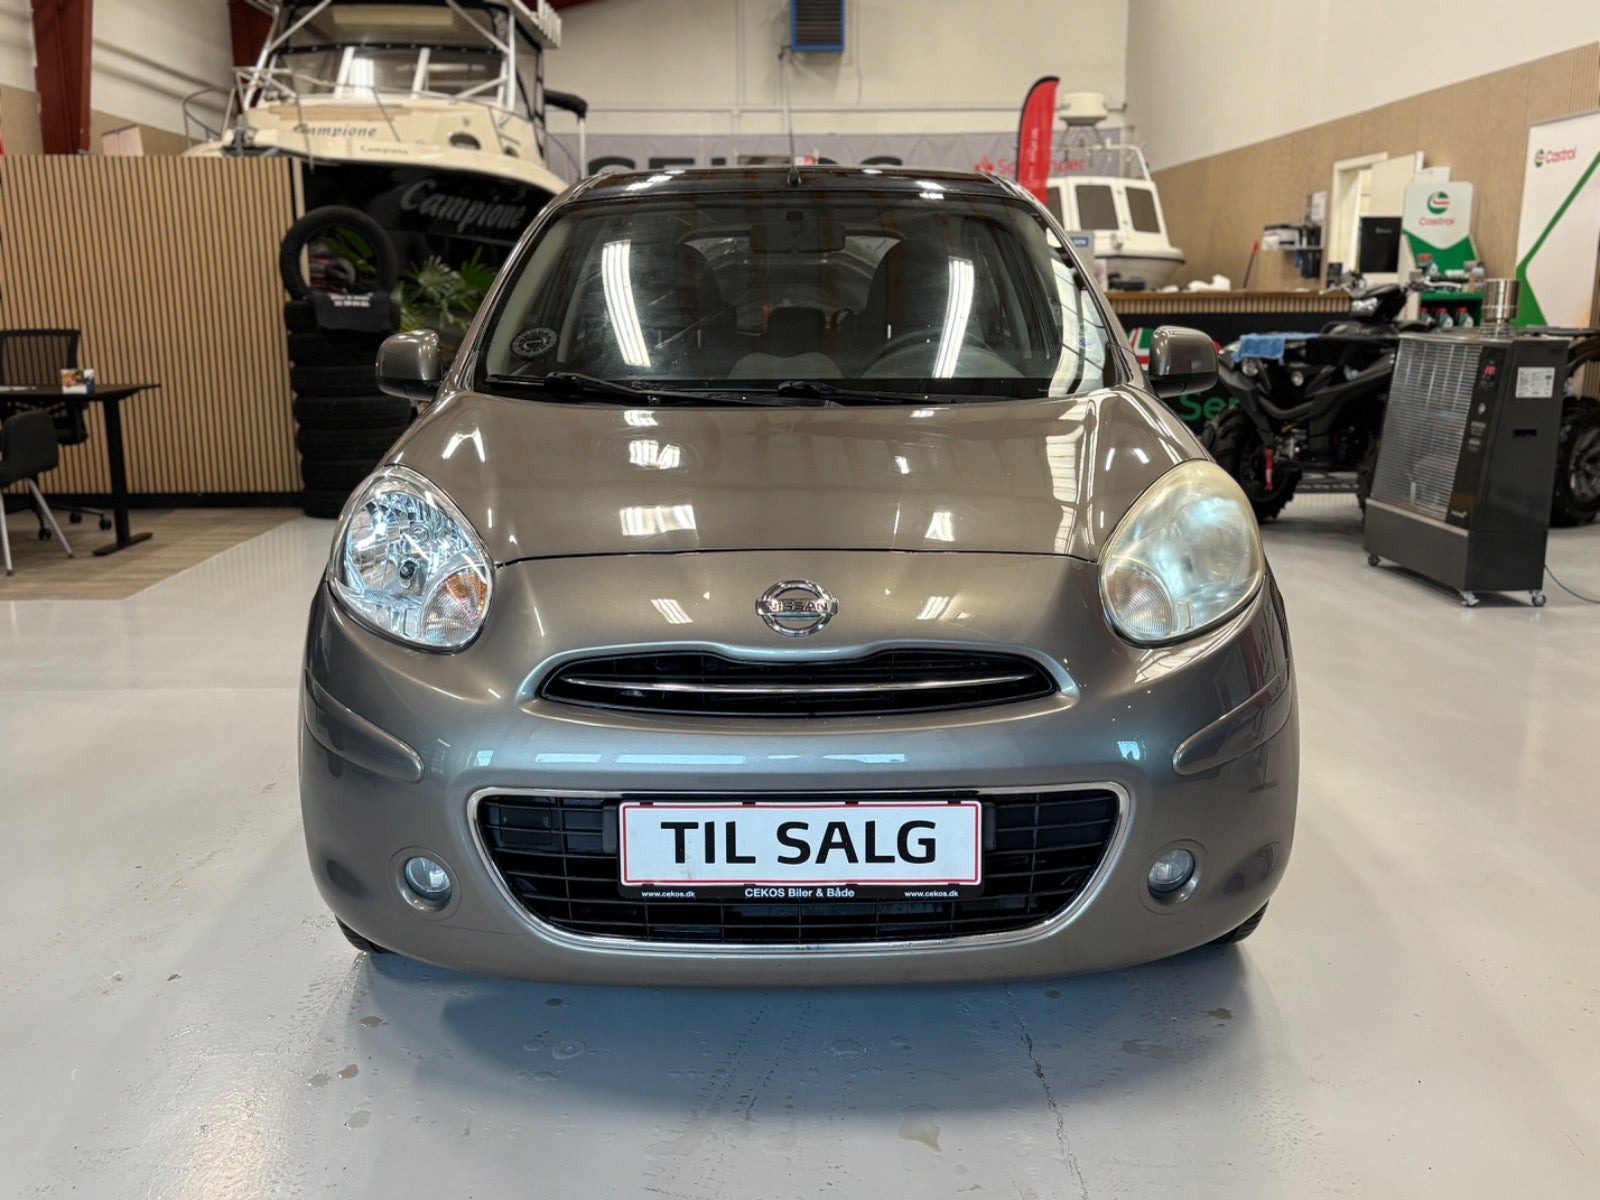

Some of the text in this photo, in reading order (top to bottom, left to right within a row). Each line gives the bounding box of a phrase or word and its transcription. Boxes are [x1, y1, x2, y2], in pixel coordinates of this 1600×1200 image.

[1546, 147, 1577, 163] Castrol
[400, 179, 528, 234] Campione
[767, 601, 828, 611] NISSAN
[660, 819, 937, 865] TIL SALG
[641, 890, 696, 898] www.cekos.dk
[744, 887, 855, 898] CEKOS Biler & Både
